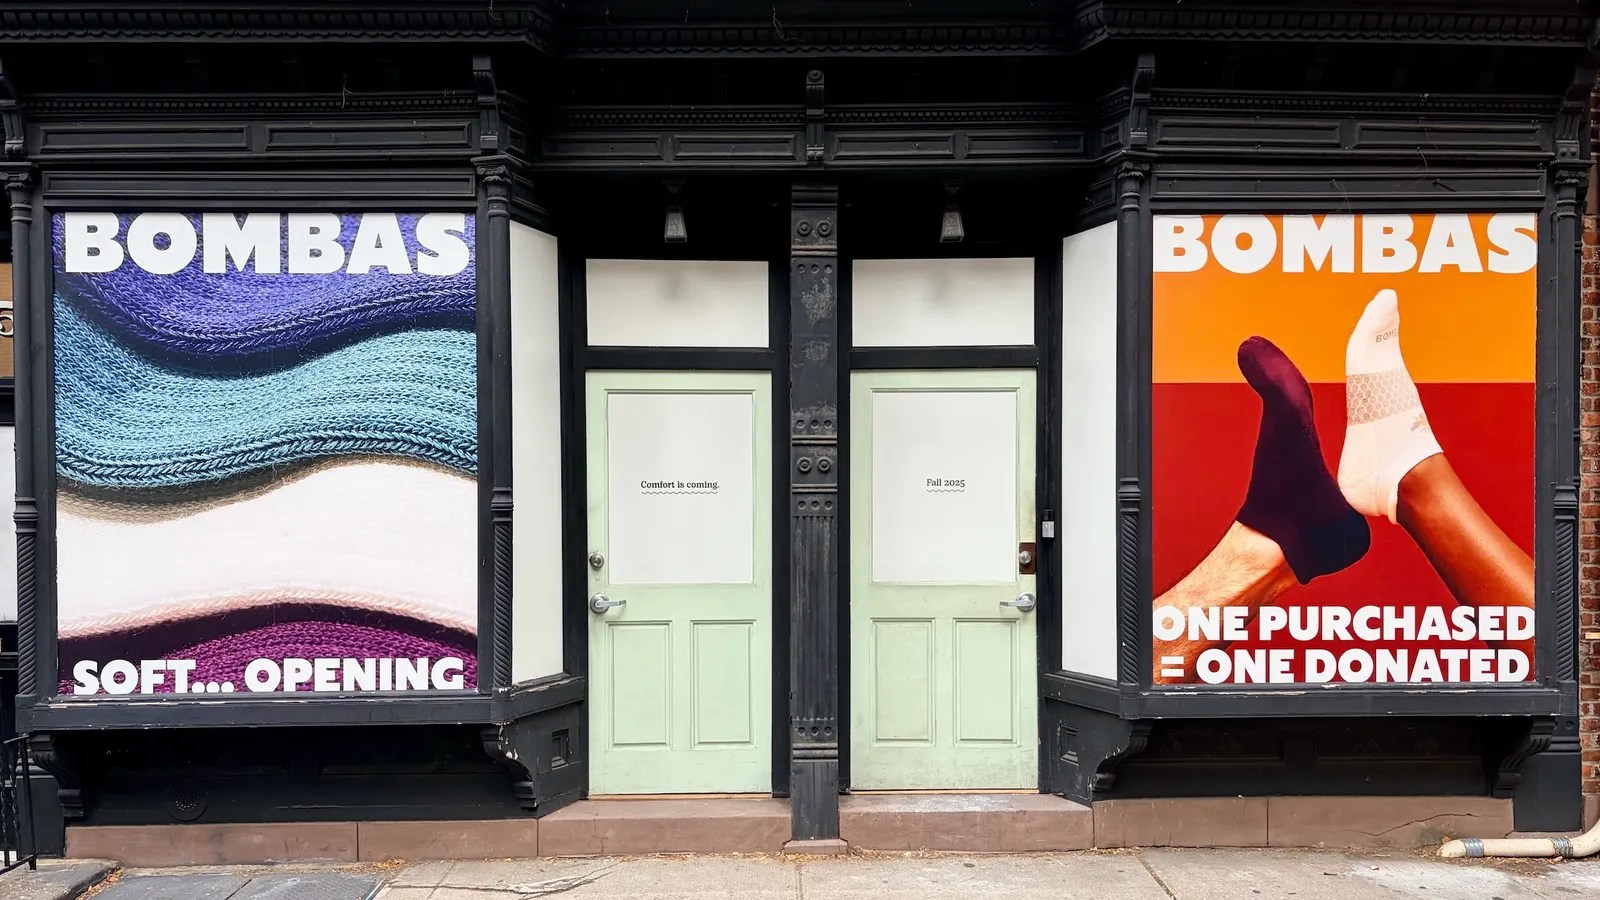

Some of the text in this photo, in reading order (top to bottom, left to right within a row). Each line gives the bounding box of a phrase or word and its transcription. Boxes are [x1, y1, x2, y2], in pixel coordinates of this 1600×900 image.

[64, 213, 470, 276] BOMBAS
[1153, 213, 1537, 274] BOMBAS
[640, 480, 720, 490] Comfort is coming.
[926, 478, 966, 488] Fall 2025
[1153, 605, 1536, 641] ONE PURCHASED
[73, 657, 465, 695] SOFT... OPENING
[1196, 649, 1295, 684] ONE
[1305, 648, 1530, 683] DONATED
